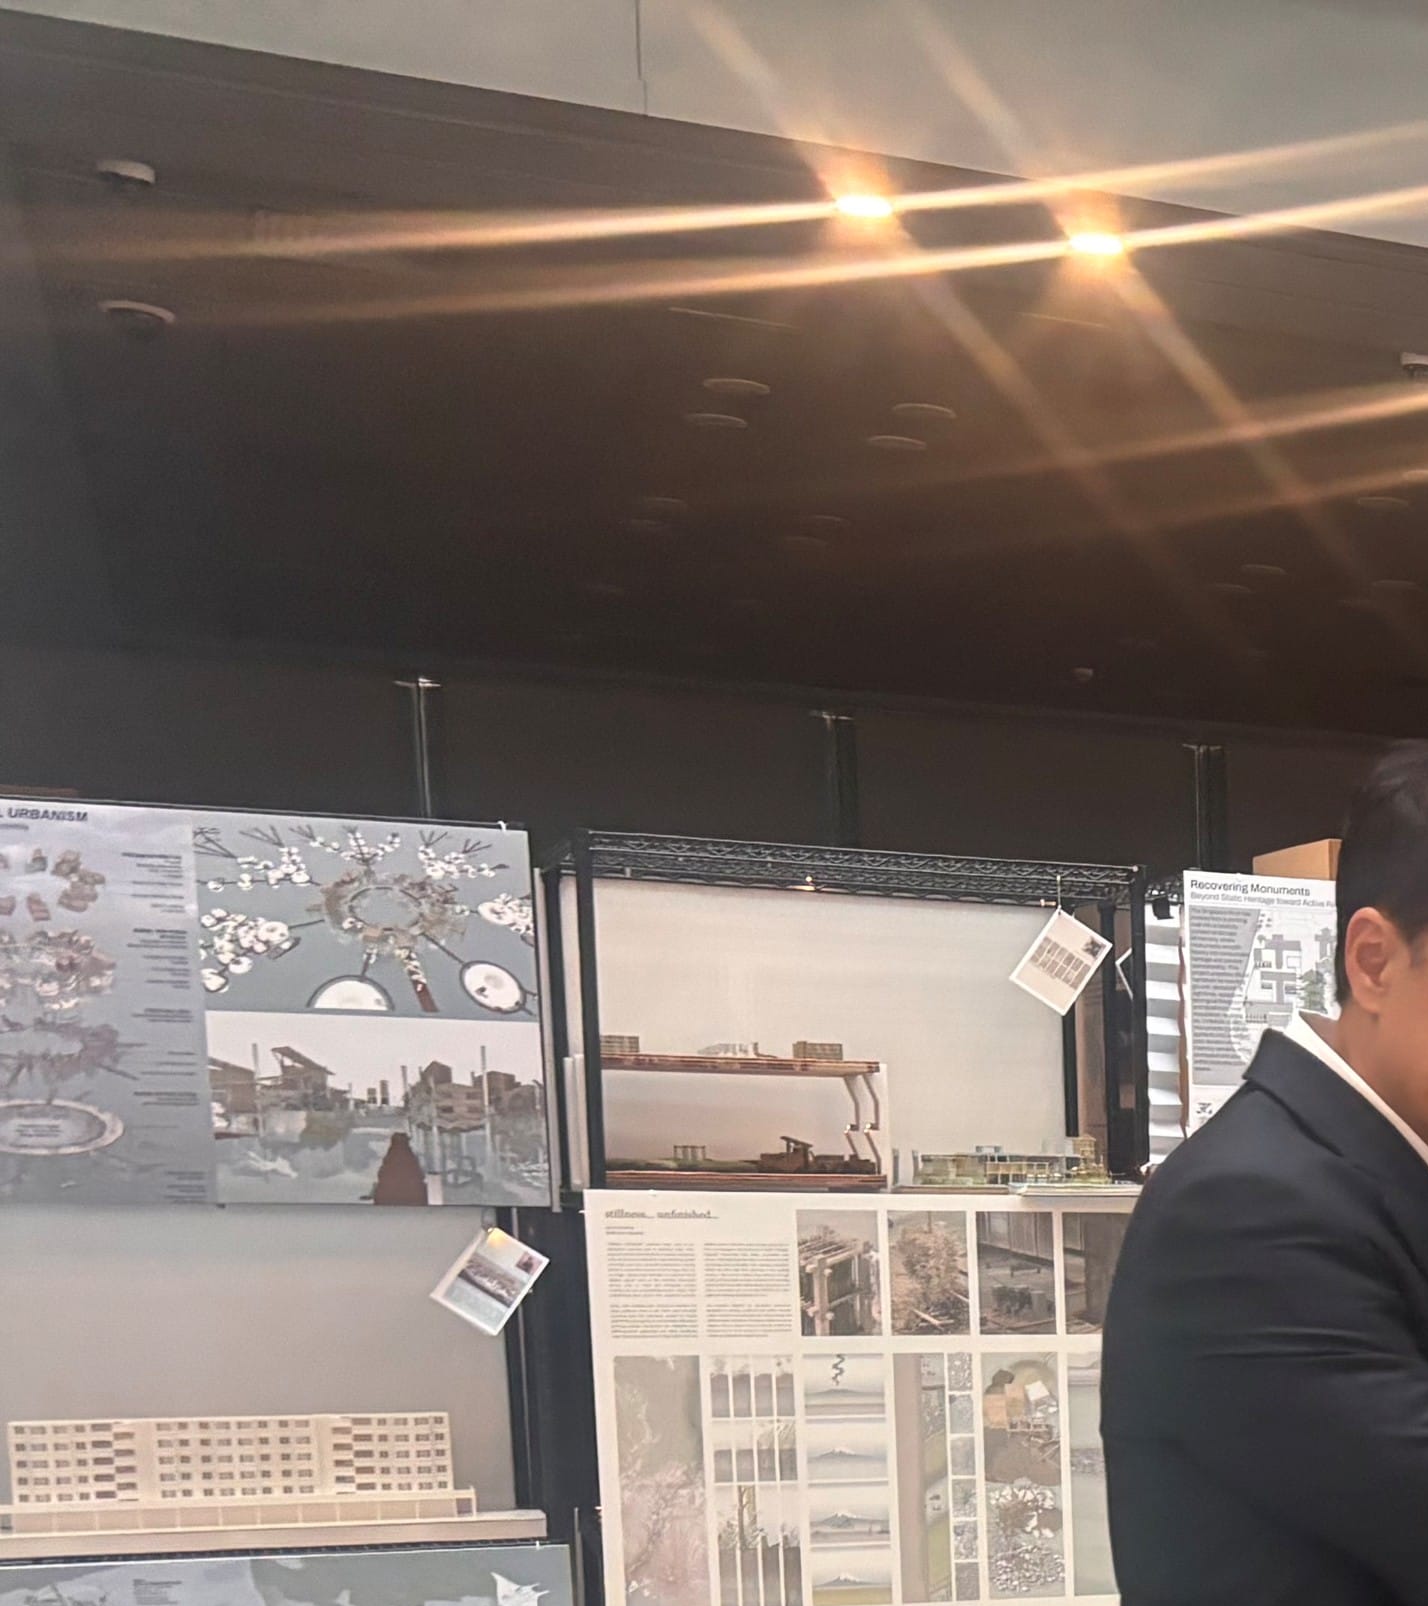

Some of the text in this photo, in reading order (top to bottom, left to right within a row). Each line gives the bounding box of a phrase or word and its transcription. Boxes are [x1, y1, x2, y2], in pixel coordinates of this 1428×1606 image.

[8, 807, 88, 821] URBANISM
[1190, 879, 1311, 897] Recovering Monuments
